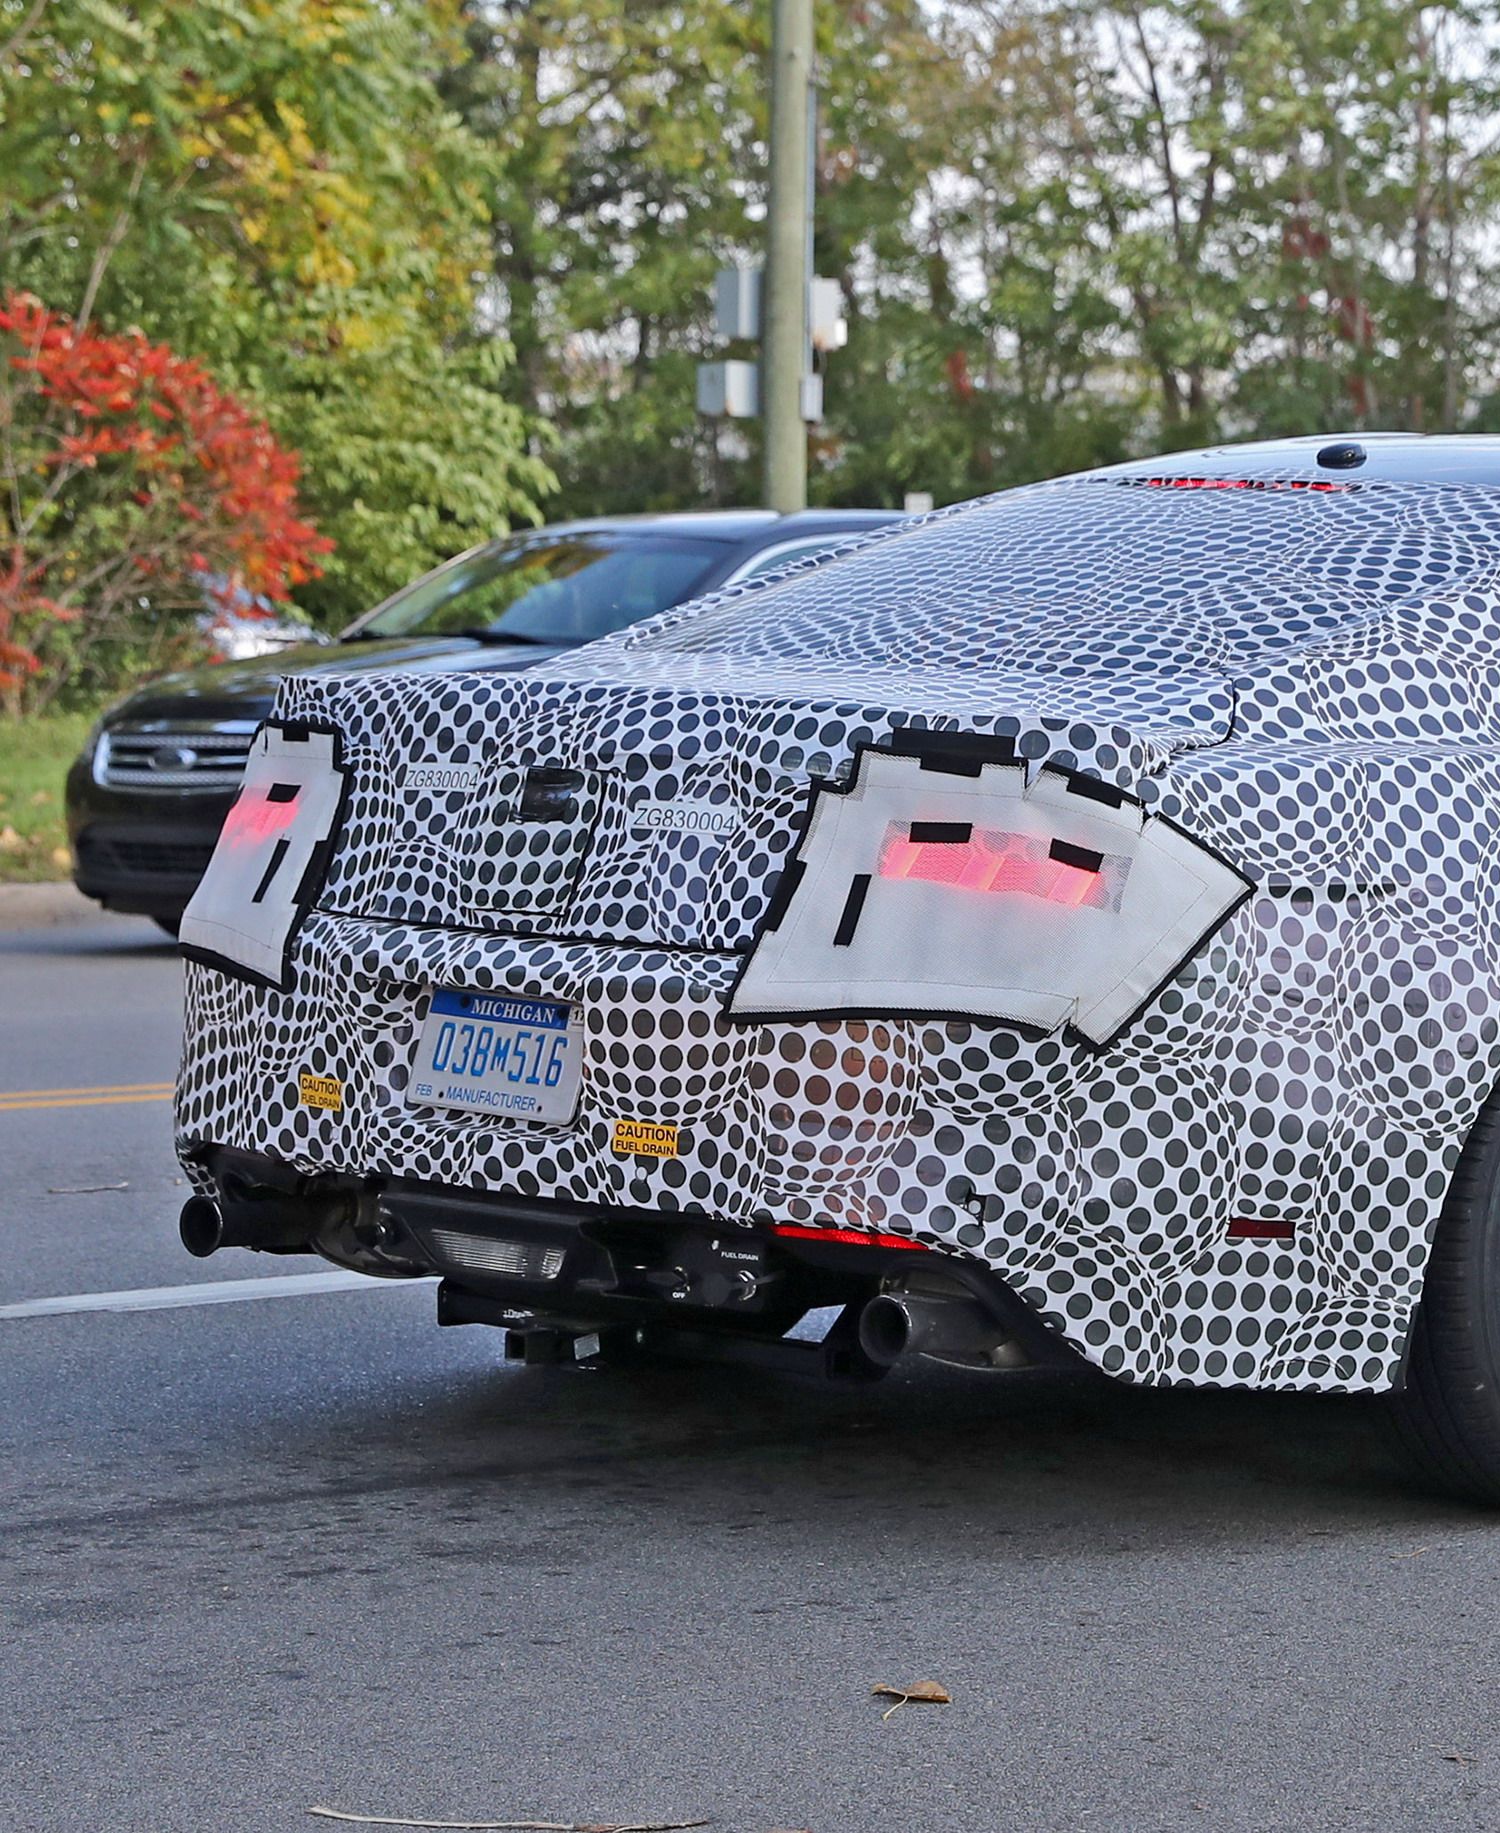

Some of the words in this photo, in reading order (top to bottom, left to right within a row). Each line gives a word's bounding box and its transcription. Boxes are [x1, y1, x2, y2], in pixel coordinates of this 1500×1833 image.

[404, 769, 479, 790] ZG830004
[634, 807, 735, 834] ZG830004
[471, 999, 555, 1024] MICHIGAN
[432, 1022, 568, 1087] 038M516
[301, 1078, 342, 1096] CAUTION
[415, 1083, 433, 1097] FEB
[301, 1093, 318, 1105] FUEL
[318, 1096, 340, 1109] DRAIN
[446, 1086, 537, 1112] MANUFACTURER
[615, 1123, 676, 1143] CAUTION
[615, 1139, 641, 1152] FUEL
[642, 1143, 675, 1156] DRAIN
[721, 1251, 738, 1260] FUEL
[738, 1252, 759, 1261] DRAIN
[672, 1291, 686, 1300] OFF
